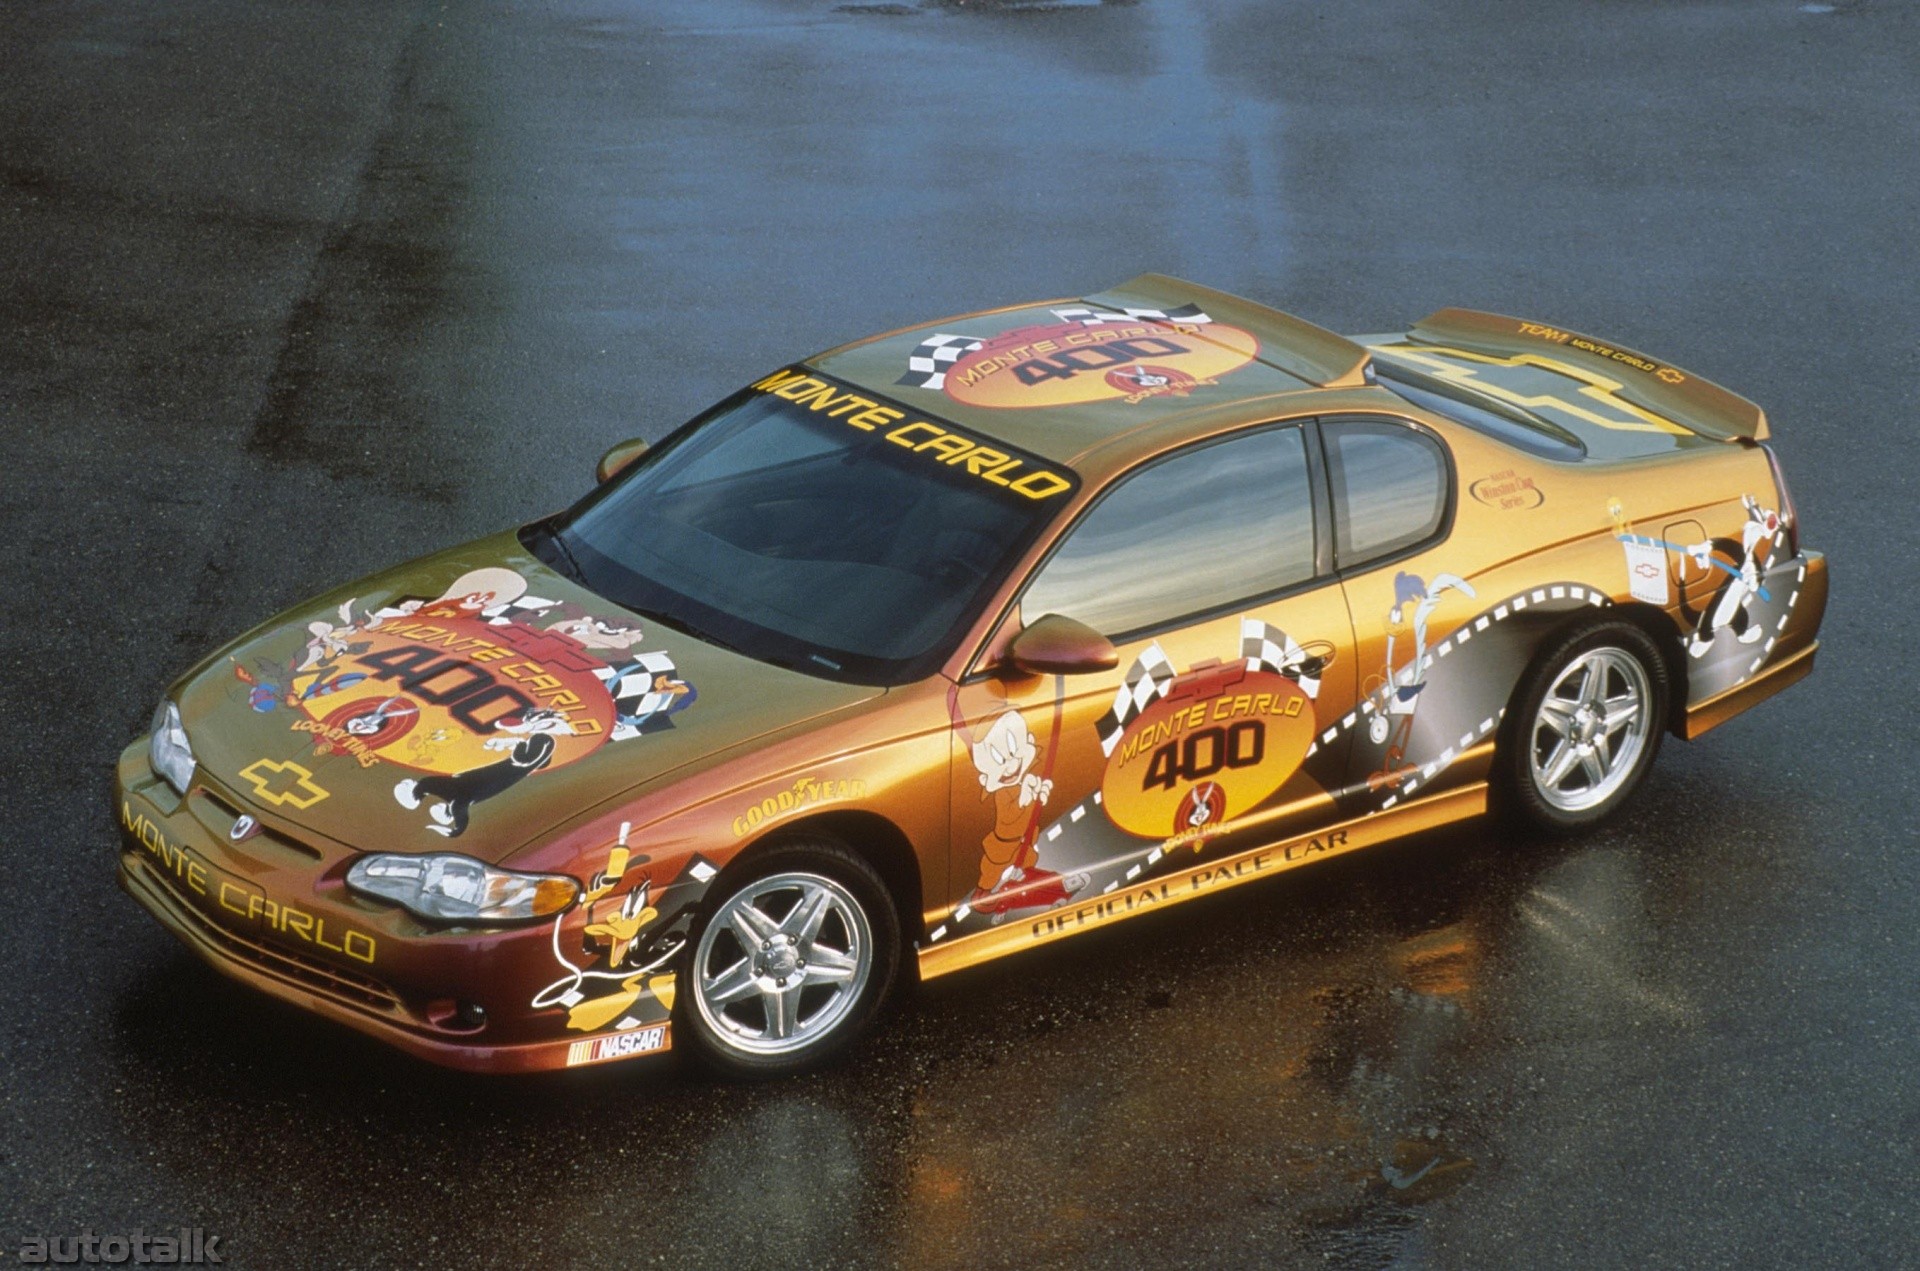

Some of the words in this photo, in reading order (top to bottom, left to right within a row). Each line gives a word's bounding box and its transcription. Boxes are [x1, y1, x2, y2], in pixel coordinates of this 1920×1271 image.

[956, 340, 1061, 387] MONTE
[1065, 325, 1201, 346] CARLO
[1010, 337, 1191, 386] 400
[1518, 322, 1569, 343] TEAM
[1569, 338, 1614, 357] MONTE
[1612, 352, 1656, 372] CARLO
[751, 370, 905, 432] MONTE
[885, 422, 1071, 499] CARLO
[355, 644, 540, 735] 400
[377, 620, 515, 662] MONTE
[500, 661, 603, 736] CARLO
[1118, 702, 1208, 768] MONTE
[1212, 693, 1304, 722] CARLO
[1142, 719, 1265, 792] 400
[122, 801, 207, 896] MONTE
[219, 881, 376, 963] CARLO
[1031, 884, 1181, 939] OFFICIAL
[1191, 850, 1273, 891] PACE
[1284, 829, 1350, 863] CAR
[600, 1028, 665, 1059] NASCAR
